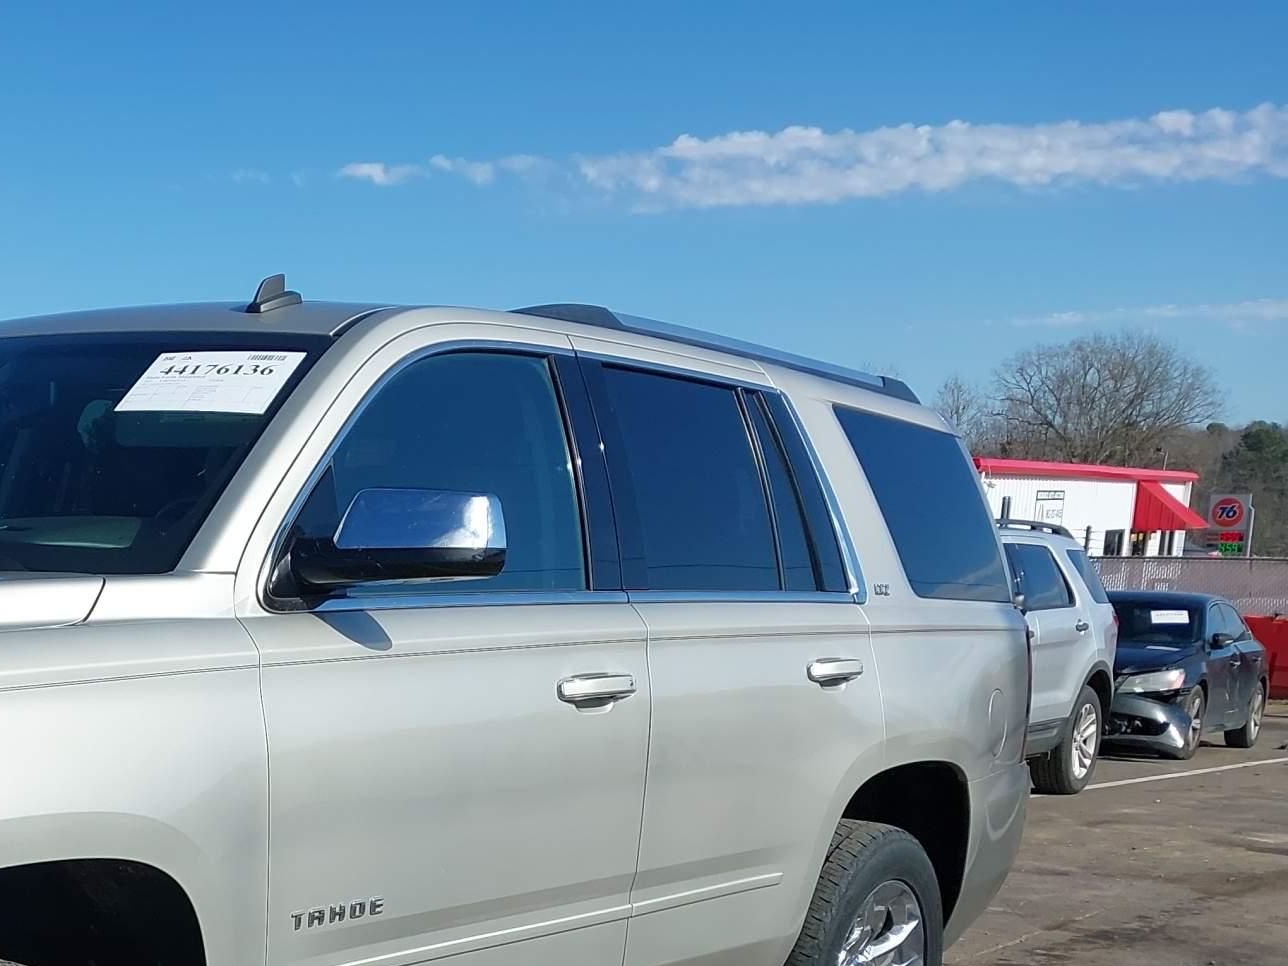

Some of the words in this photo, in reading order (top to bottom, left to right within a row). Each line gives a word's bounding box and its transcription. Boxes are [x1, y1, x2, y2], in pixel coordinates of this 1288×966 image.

[160, 363, 279, 376] 44176136
[1216, 503, 1240, 520] 76
[291, 897, 384, 931] TAHOE
